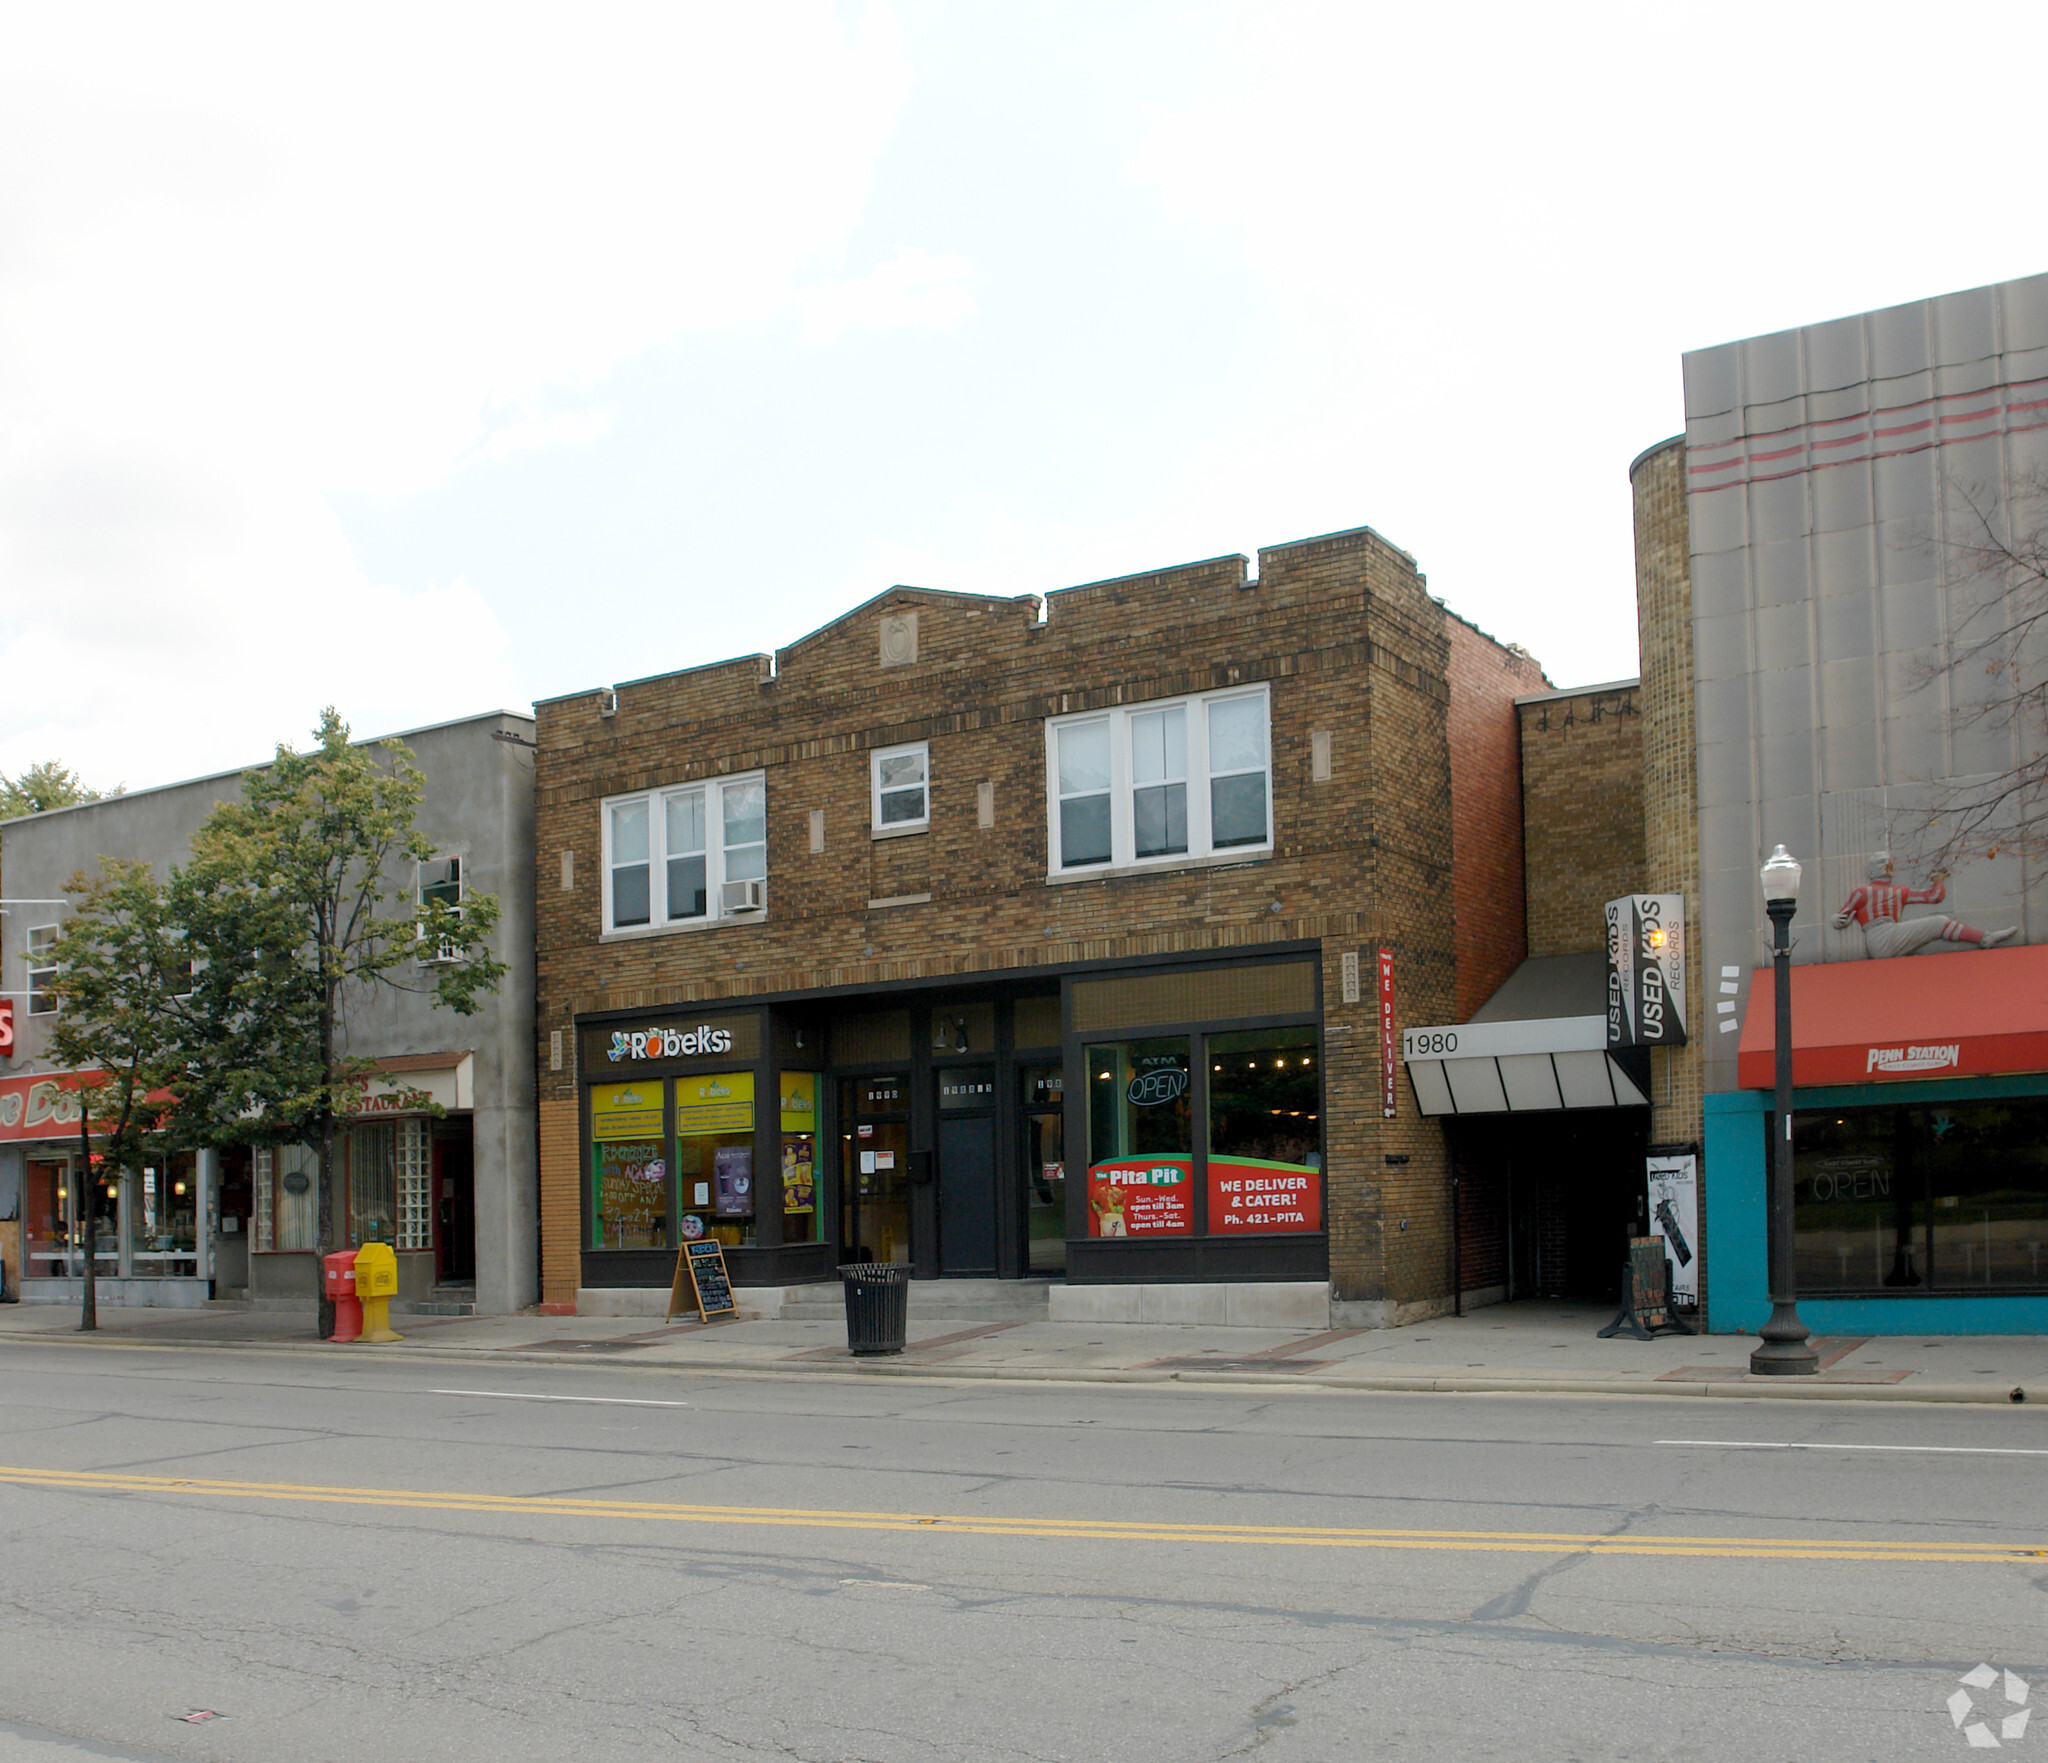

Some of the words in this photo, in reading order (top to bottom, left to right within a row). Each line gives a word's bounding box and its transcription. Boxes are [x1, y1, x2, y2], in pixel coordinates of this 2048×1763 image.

[1608, 906, 1619, 965] KIDS
[1669, 921, 1680, 990] RECORDS
[1383, 964, 1391, 991] WE
[1609, 972, 1621, 1042] USED
[1643, 967, 1664, 1039] USED
[1384, 1002, 1394, 1105] DELIVER
[1405, 1033, 1458, 1055] 1980
[1867, 1048, 1904, 1073] PENN
[1907, 1044, 1960, 1067] STATION
[1129, 1075, 1183, 1100] OPEN
[1110, 1170, 1148, 1185] Pita
[1151, 1168, 1180, 1184] Pit
[1220, 1180, 1242, 1192] WE
[1245, 1177, 1308, 1191] DELIVER
[1814, 1170, 1890, 1201] OPEN
[1231, 1196, 1243, 1208] &
[1245, 1193, 1297, 1207] CATER!
[1165, 1220, 1184, 1228] 4am
[1224, 1214, 1244, 1225] Ph.
[1246, 1212, 1305, 1224] 421-PITA
